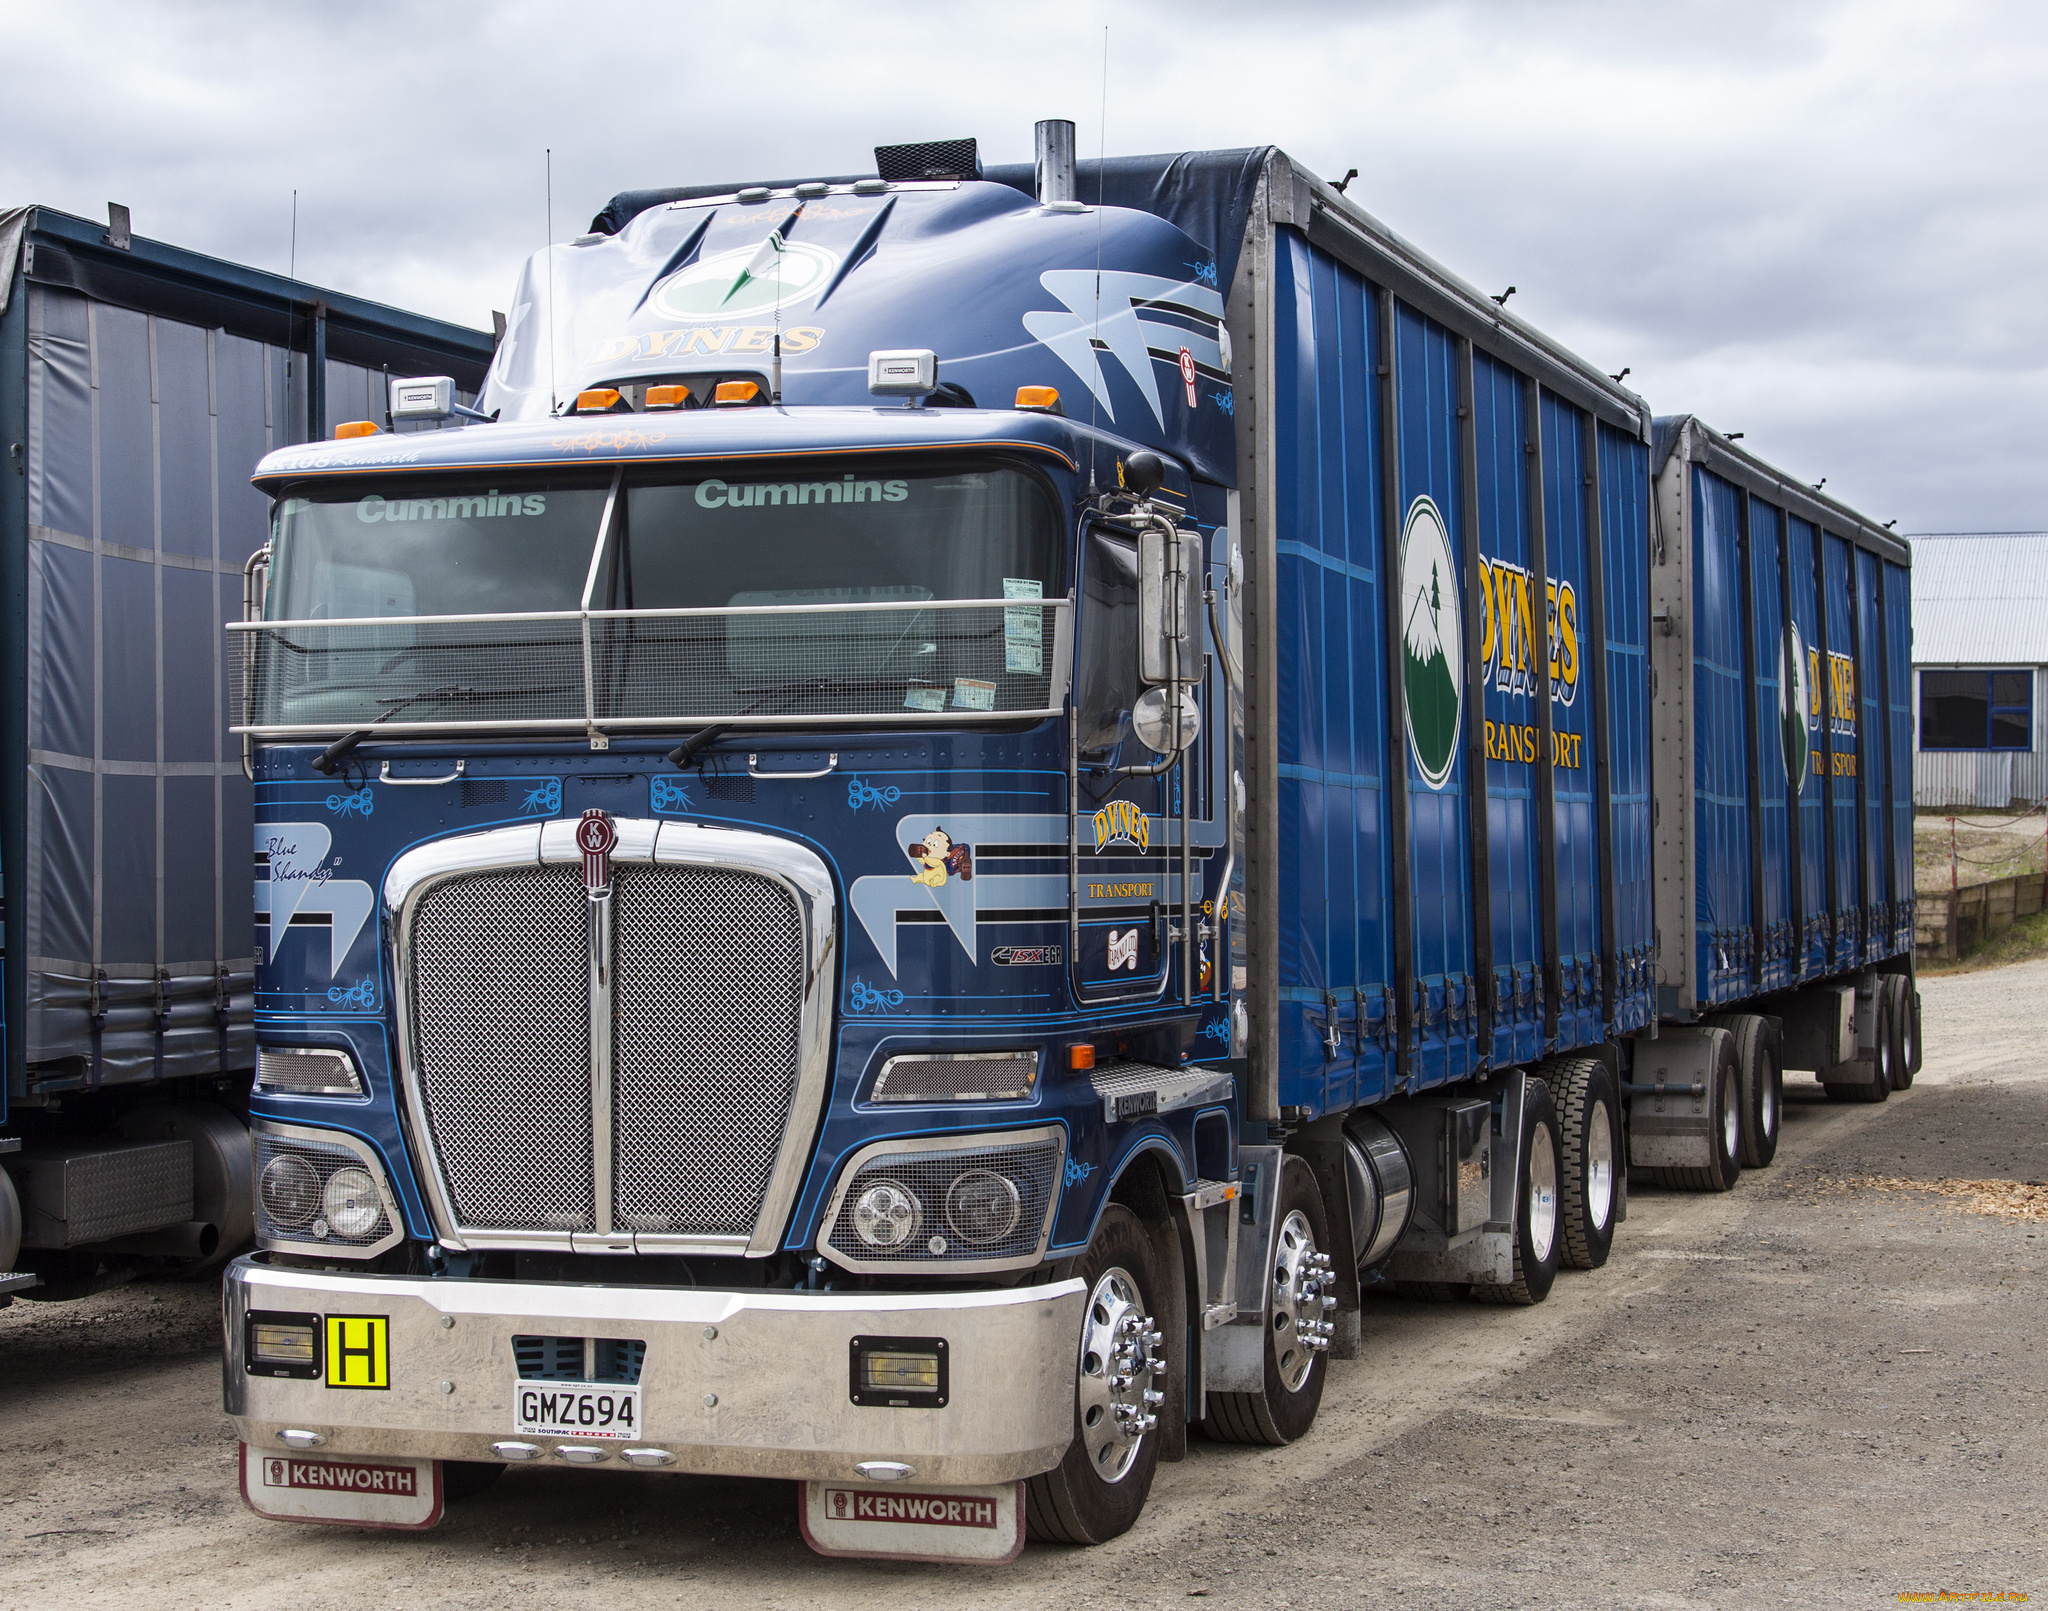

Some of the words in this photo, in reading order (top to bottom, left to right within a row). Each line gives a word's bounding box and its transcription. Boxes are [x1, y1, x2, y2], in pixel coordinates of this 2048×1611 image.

[583, 326, 824, 368] DYNES
[332, 450, 422, 467] Kenworth
[356, 489, 546, 523] Cummins
[694, 474, 909, 509] Cummins
[1484, 718, 1582, 769] RANSORT
[1092, 800, 1149, 855] DYNES
[1087, 882, 1154, 899] TRANSPORT
[1011, 949, 1043, 963] ISX
[1043, 945, 1062, 965] EGR
[1117, 1091, 1157, 1116] KENWORTH
[338, 1321, 376, 1383] H
[522, 1391, 634, 1427] GMZ694
[292, 1464, 412, 1492] KENWORTH
[858, 1496, 992, 1523] KENWORTH
